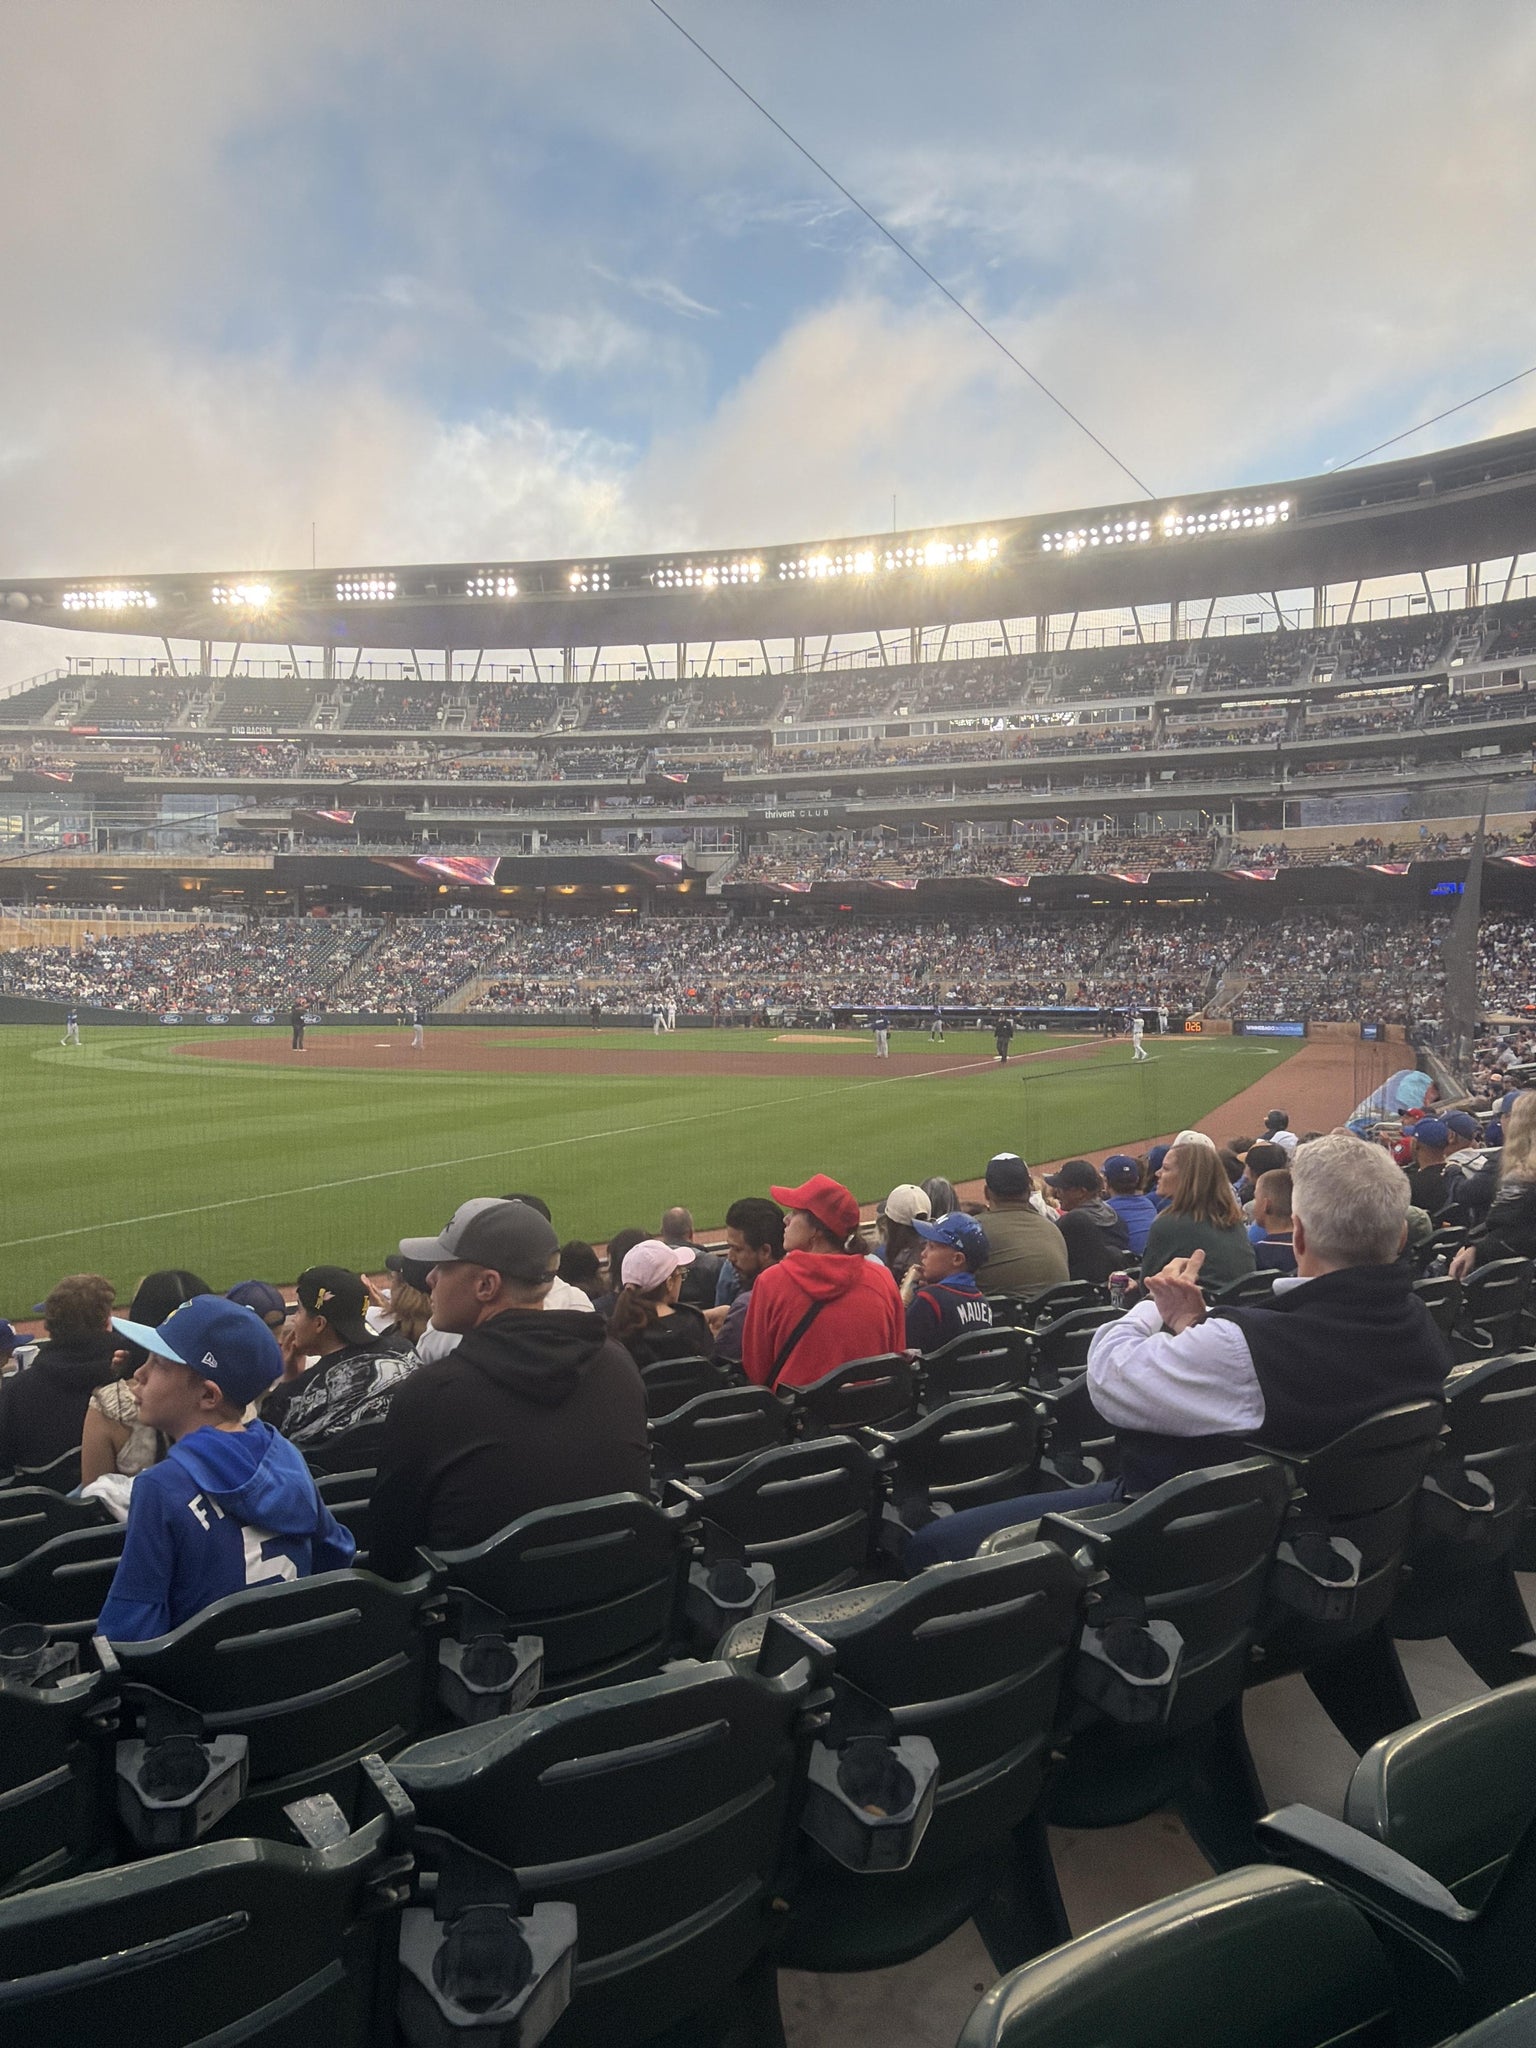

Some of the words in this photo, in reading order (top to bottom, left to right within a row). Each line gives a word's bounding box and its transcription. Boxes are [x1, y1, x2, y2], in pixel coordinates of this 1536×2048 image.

[232, 726, 245, 734] END
[246, 726, 272, 735] RACISM
[765, 810, 795, 819] thrivent
[162, 1014, 180, 1023] Ford
[208, 1014, 227, 1023] Ford
[254, 1014, 272, 1023] Ford
[1185, 1021, 1201, 1032] 026
[241, 1525, 297, 1585] 5
